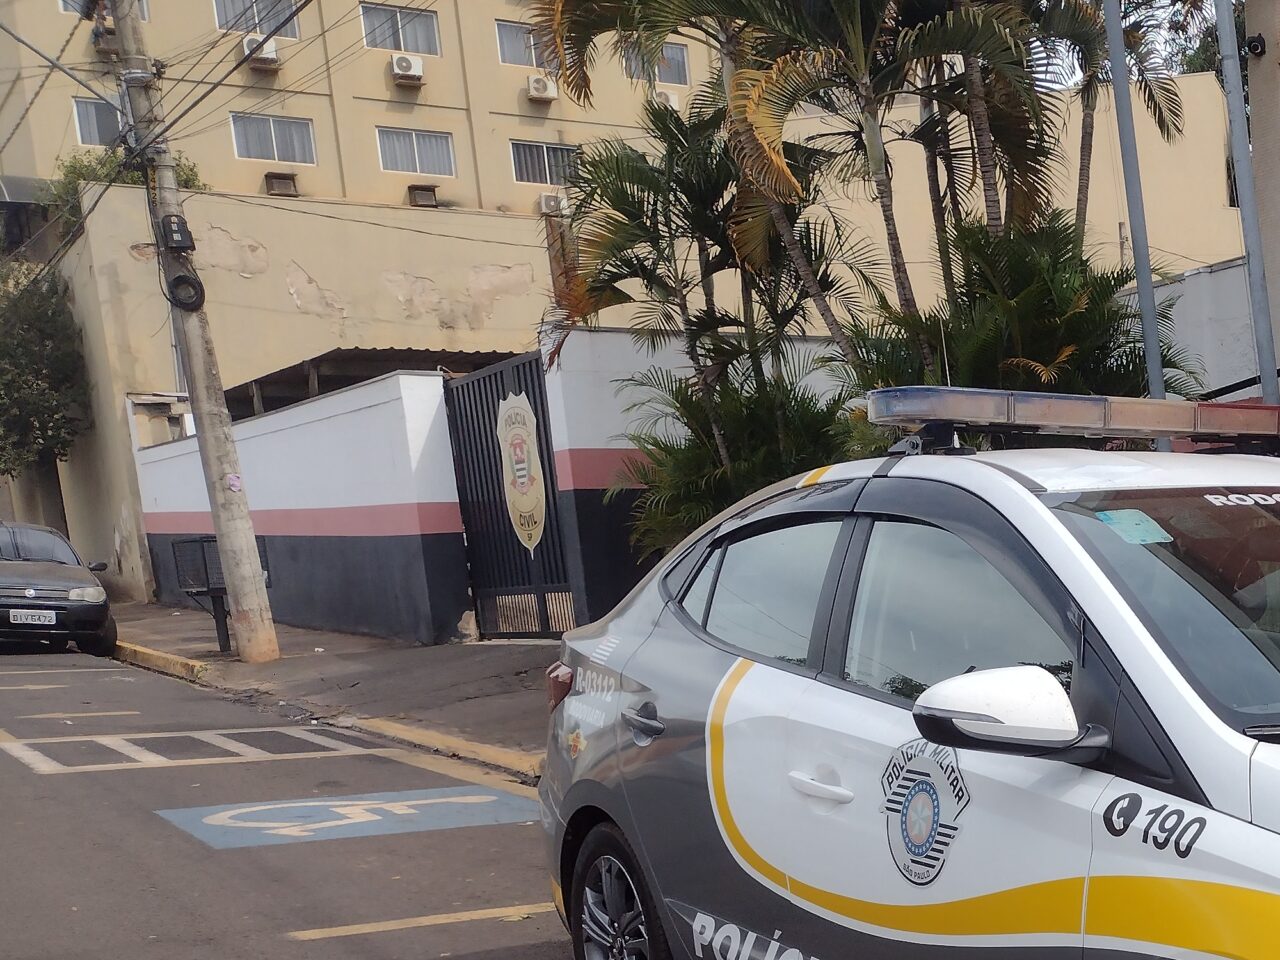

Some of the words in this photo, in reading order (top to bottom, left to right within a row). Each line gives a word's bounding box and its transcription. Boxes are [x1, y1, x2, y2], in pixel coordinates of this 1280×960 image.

[520, 513, 537, 528] CIVIL
[576, 666, 615, 702] R-03112
[928, 744, 965, 806] MILITAR
[1142, 804, 1207, 858] 190
